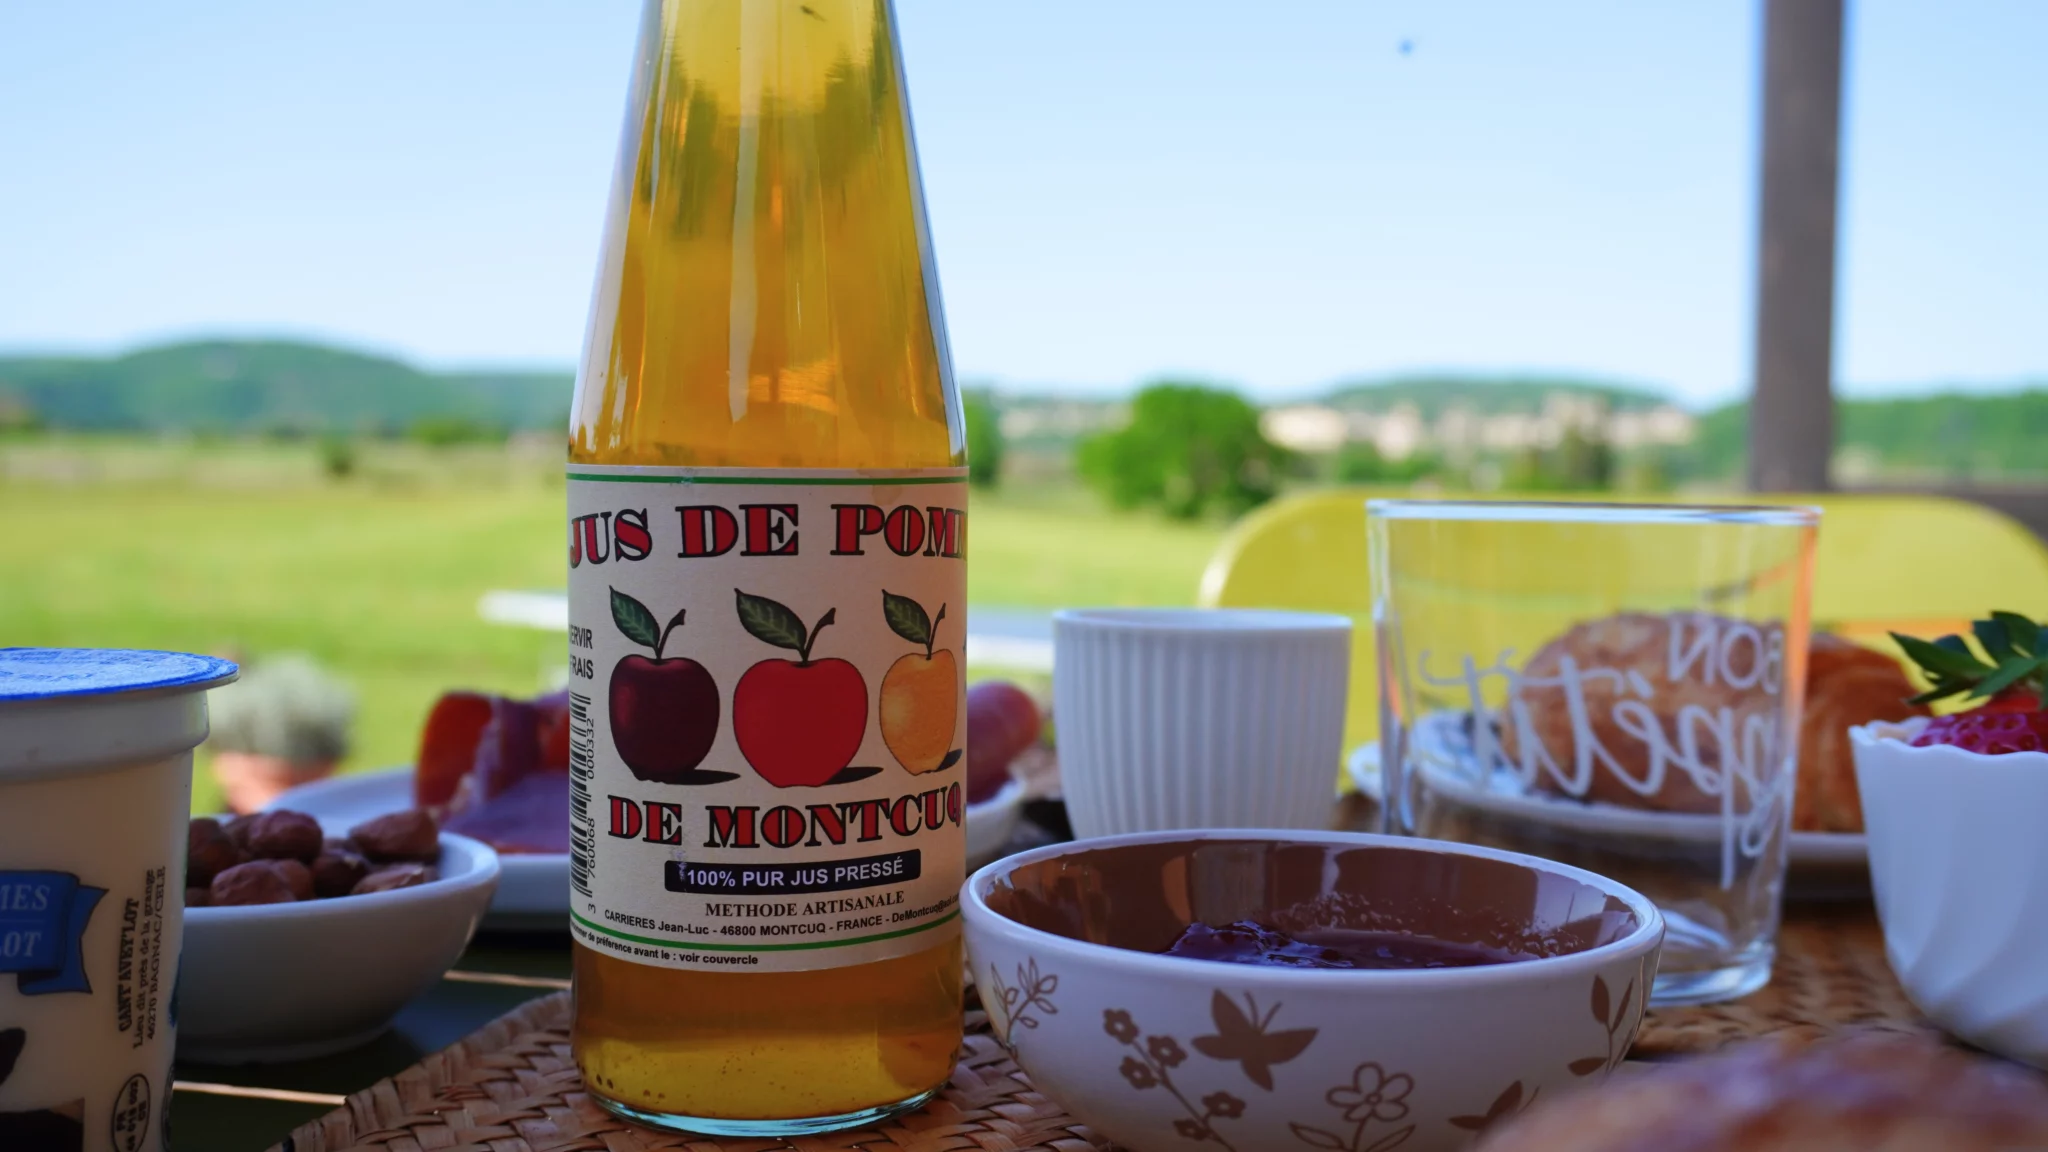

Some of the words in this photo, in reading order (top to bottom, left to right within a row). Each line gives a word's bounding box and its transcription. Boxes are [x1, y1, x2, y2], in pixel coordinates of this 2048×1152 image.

[569, 508, 653, 569] JUS
[675, 503, 799, 558] DE
[586, 717, 595, 780] 000332
[607, 794, 683, 846] DE
[703, 781, 962, 849] MONTCUQ
[587, 818, 596, 879] 760068
[687, 869, 736, 888] 100%
[742, 870, 785, 888] PUR
[790, 868, 829, 886] JUS
[834, 856, 904, 883] PRESSÉ
[143, 868, 155, 917] grange
[705, 902, 798, 918] METHODE
[802, 890, 905, 916] ARTISANALE
[140, 920, 151, 936] la
[604, 909, 656, 930] CARRIERES
[658, 922, 710, 936] Jean-Luc
[720, 924, 757, 937] 46800
[760, 922, 826, 937] MONTCUQ
[836, 915, 883, 932] FRANCE
[139, 938, 149, 955] de
[633, 946, 659, 960] avant
[661, 949, 670, 960] le
[679, 952, 700, 964] voir
[702, 954, 759, 966] couvercle
